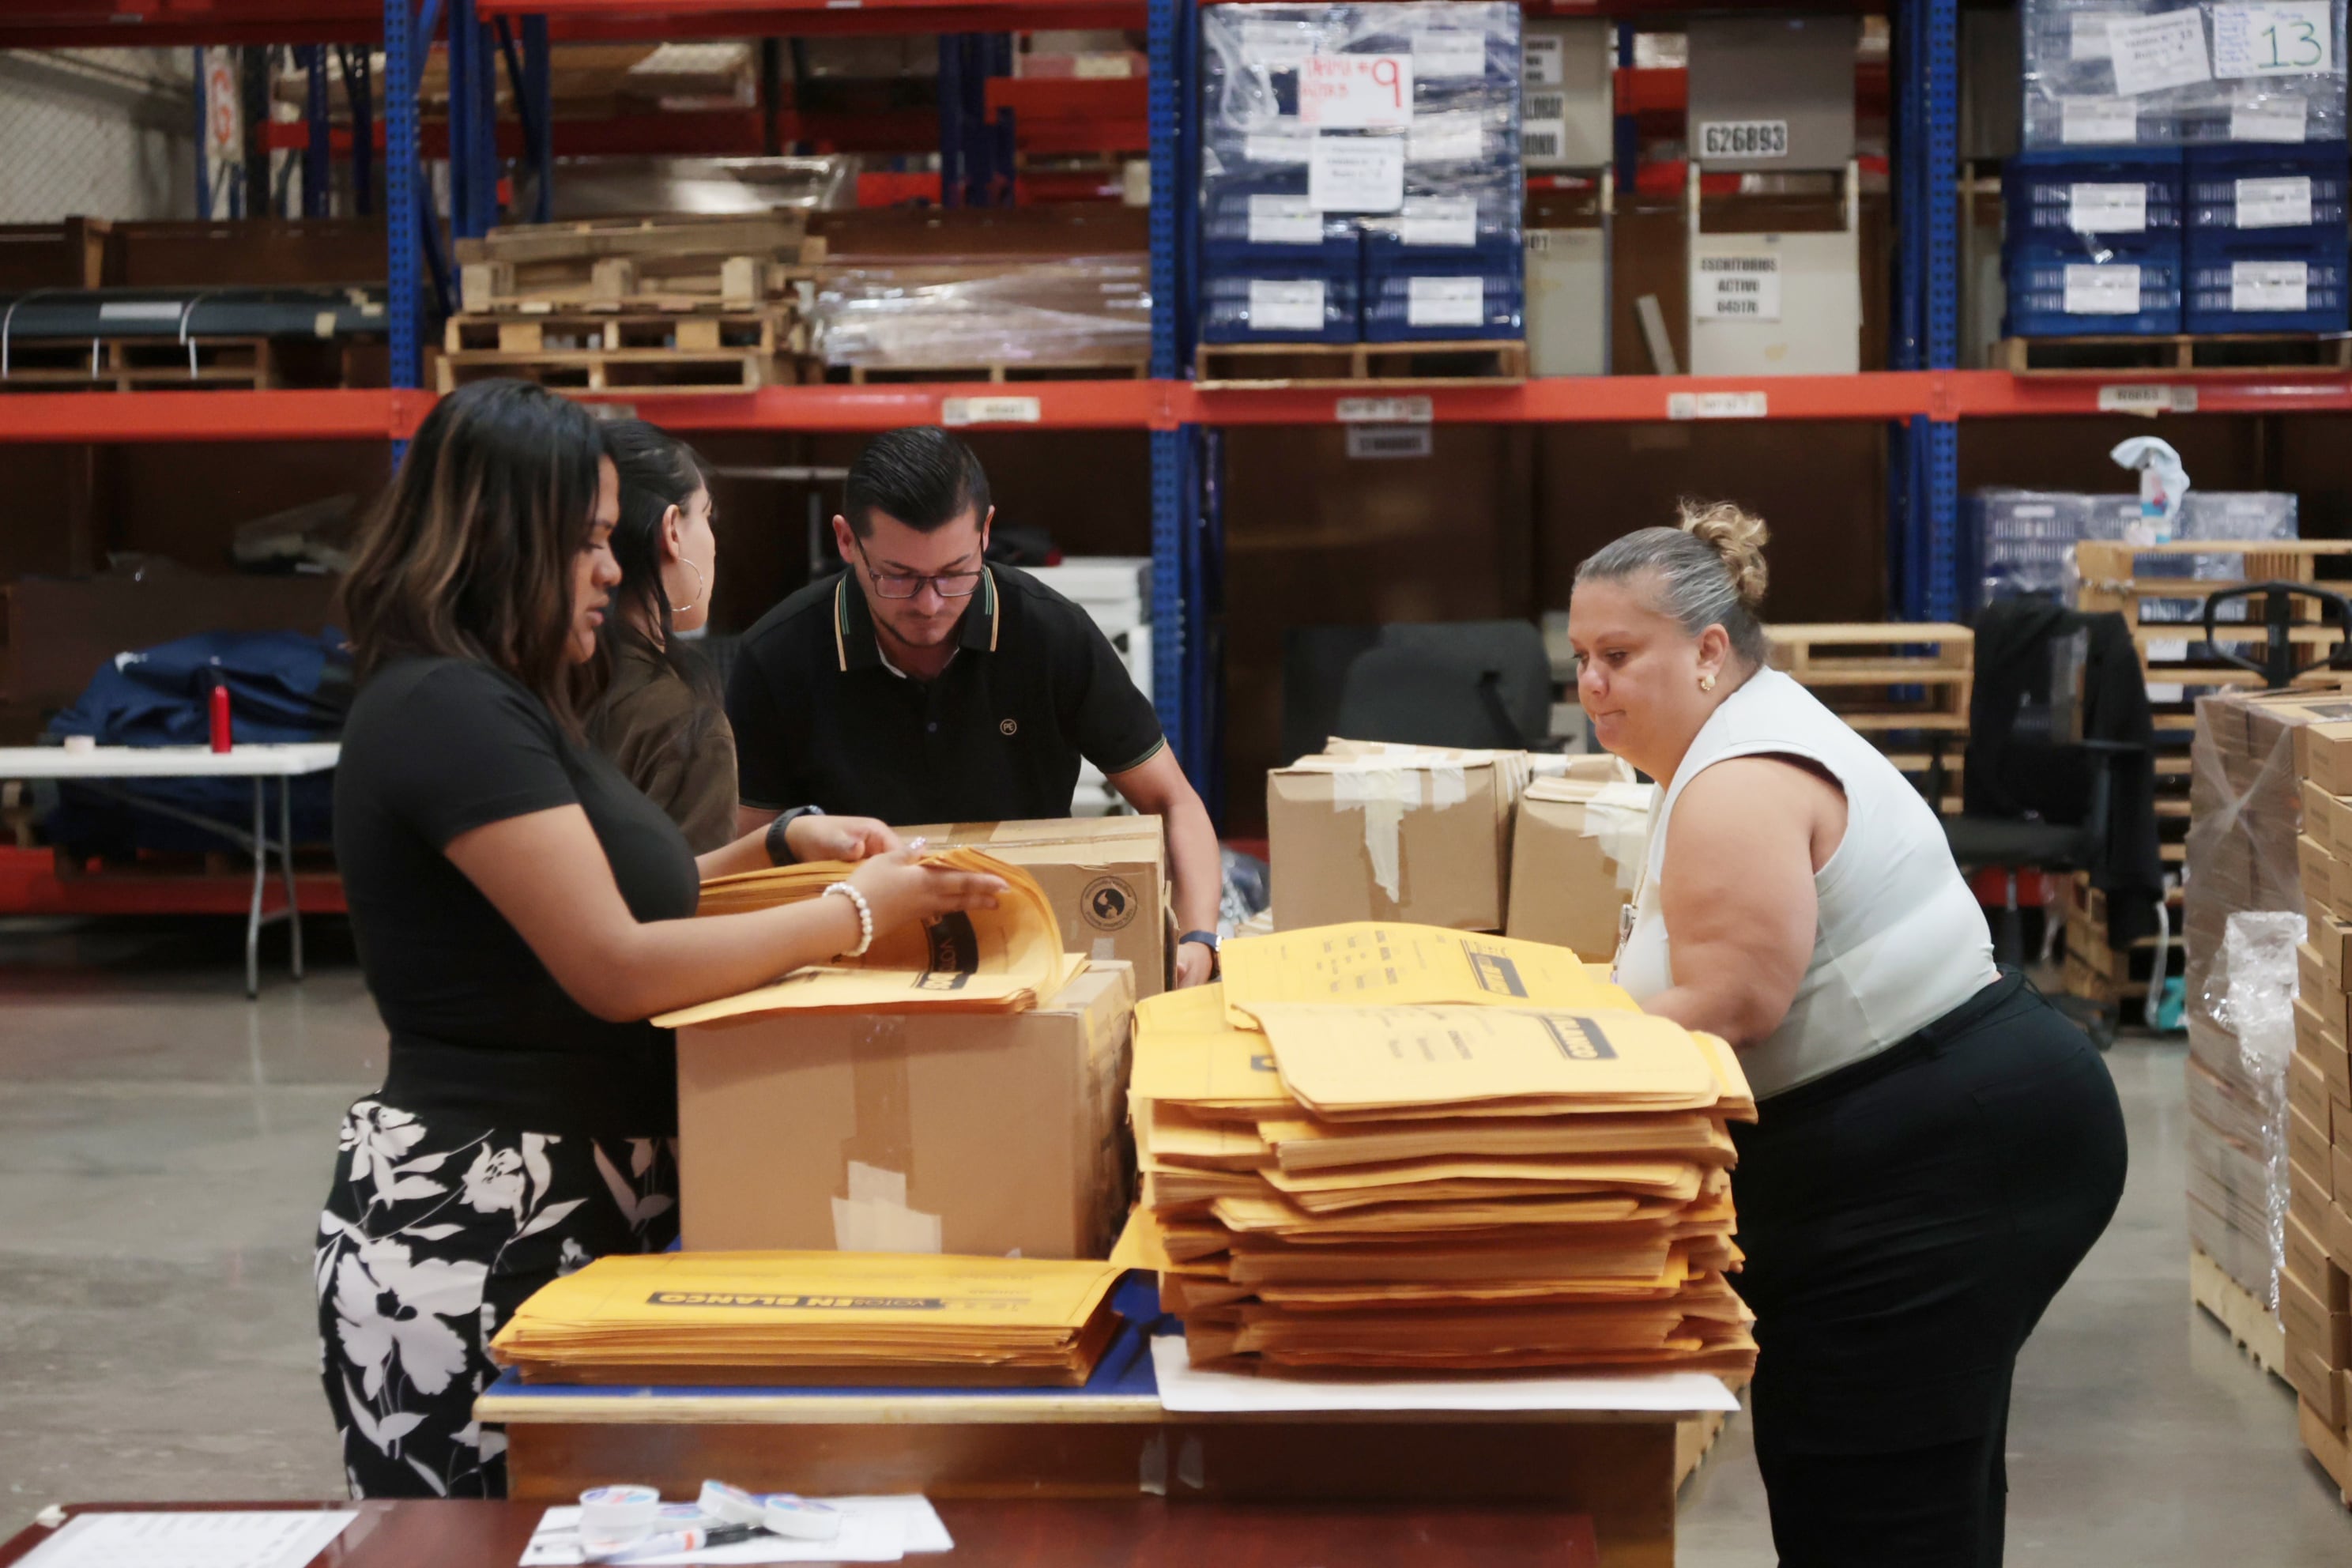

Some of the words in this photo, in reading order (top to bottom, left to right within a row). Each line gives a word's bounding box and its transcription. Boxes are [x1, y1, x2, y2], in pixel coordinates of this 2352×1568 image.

[2258, 21, 2322, 69] 13
[1707, 126, 1785, 153] 626893
[1718, 278, 1759, 292] ACTIVO
[658, 1294, 800, 1306] BLANCO
[806, 1297, 854, 1307] EN
